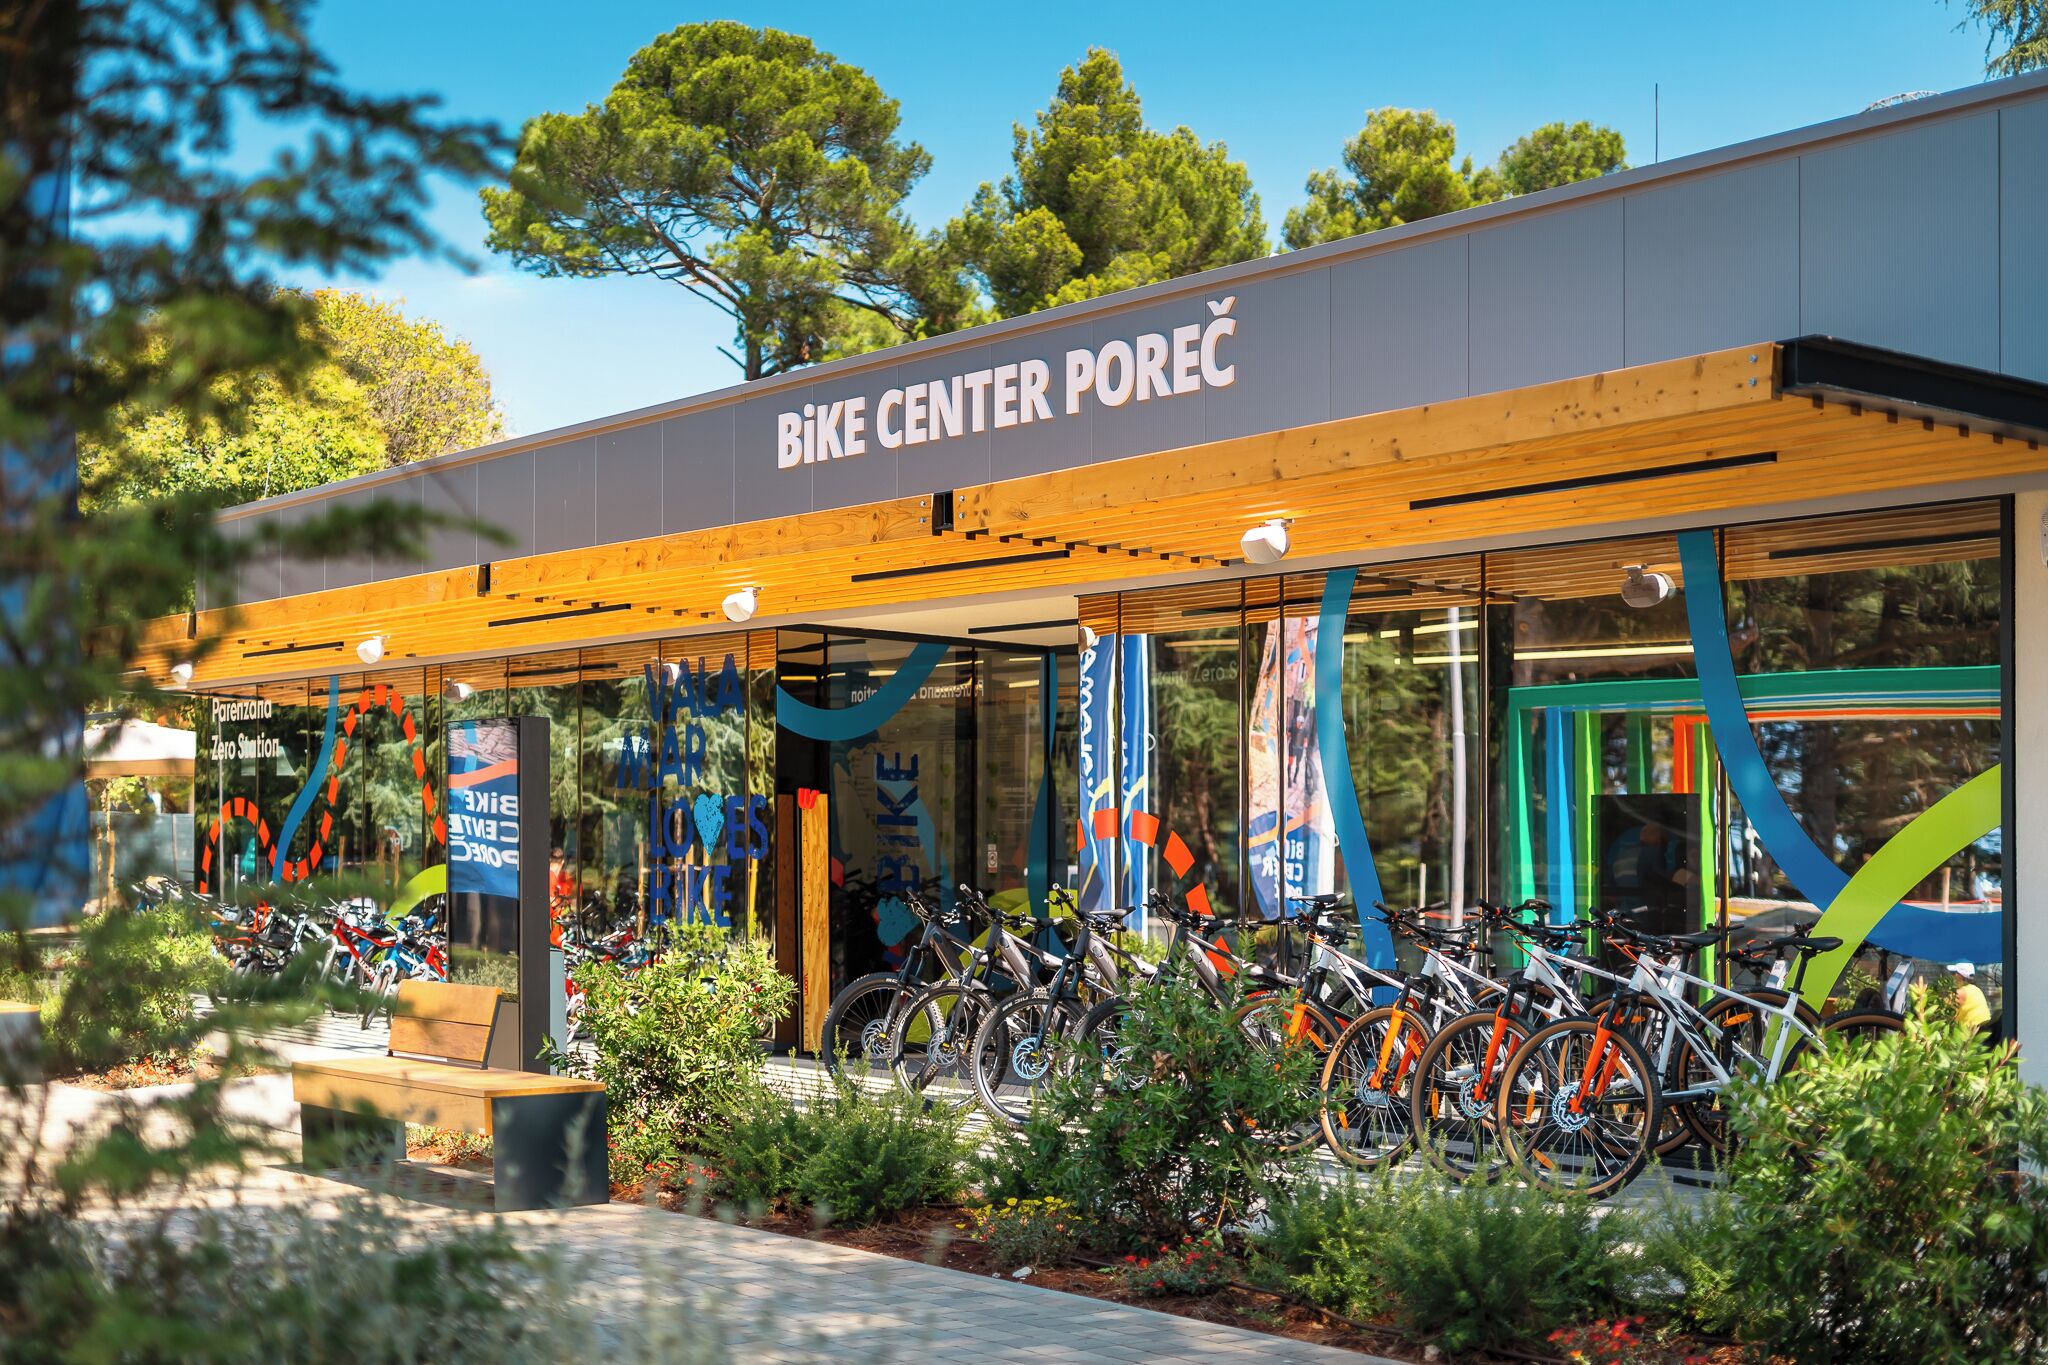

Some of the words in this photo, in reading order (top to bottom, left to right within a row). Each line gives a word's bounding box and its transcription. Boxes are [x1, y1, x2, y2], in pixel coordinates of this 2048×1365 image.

[777, 396, 867, 470] BiKE
[876, 358, 1054, 450] CENTER
[1065, 295, 1237, 416] POREČ
[211, 697, 273, 723] Parenzana
[643, 652, 745, 723] VALA
[210, 734, 237, 761] Zero
[238, 732, 280, 760] Station
[615, 723, 707, 790] MAR
[649, 862, 733, 928] BIKE
